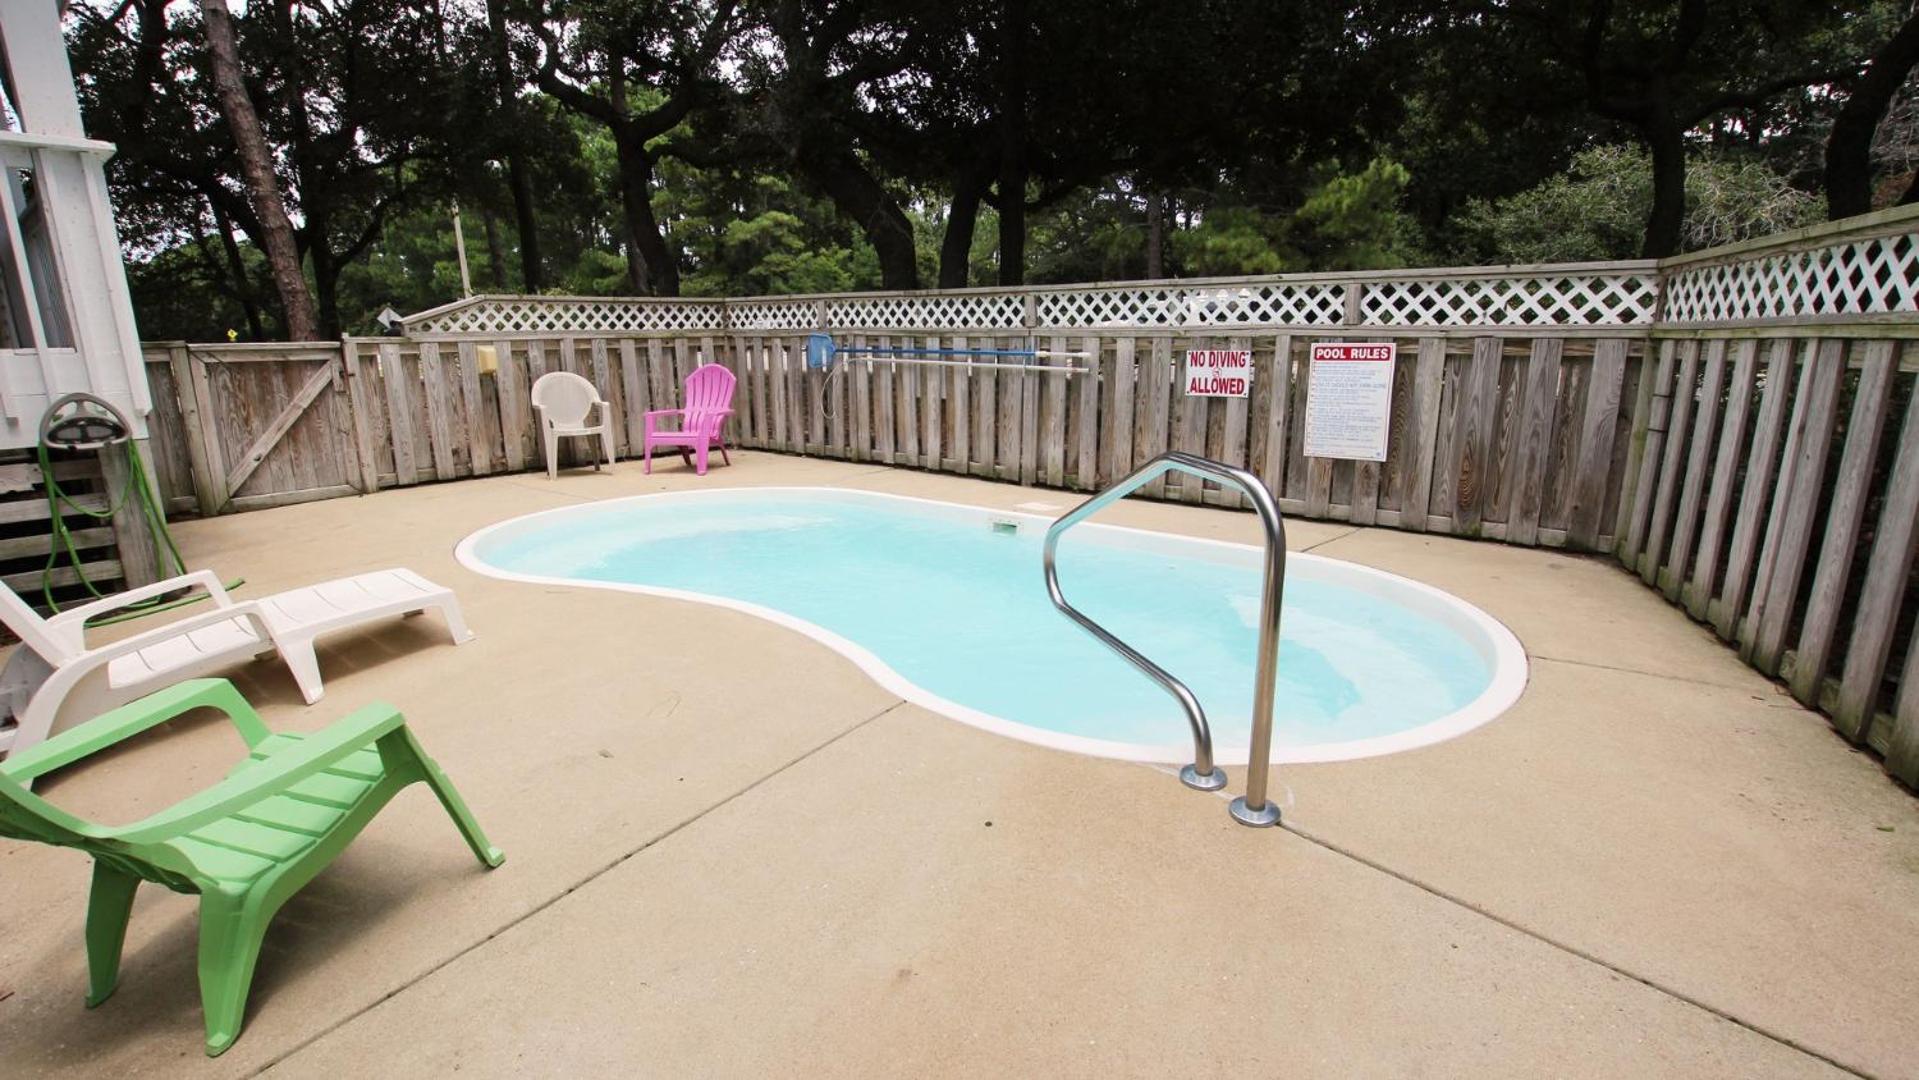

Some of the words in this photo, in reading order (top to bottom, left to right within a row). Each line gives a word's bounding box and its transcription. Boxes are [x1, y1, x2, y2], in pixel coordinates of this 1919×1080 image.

[1190, 351, 1205, 367] NO
[1209, 351, 1246, 368] DIVING
[1316, 348, 1346, 359] POOL
[1351, 348, 1389, 359] RULES
[1190, 377, 1245, 394] ALLOWED
